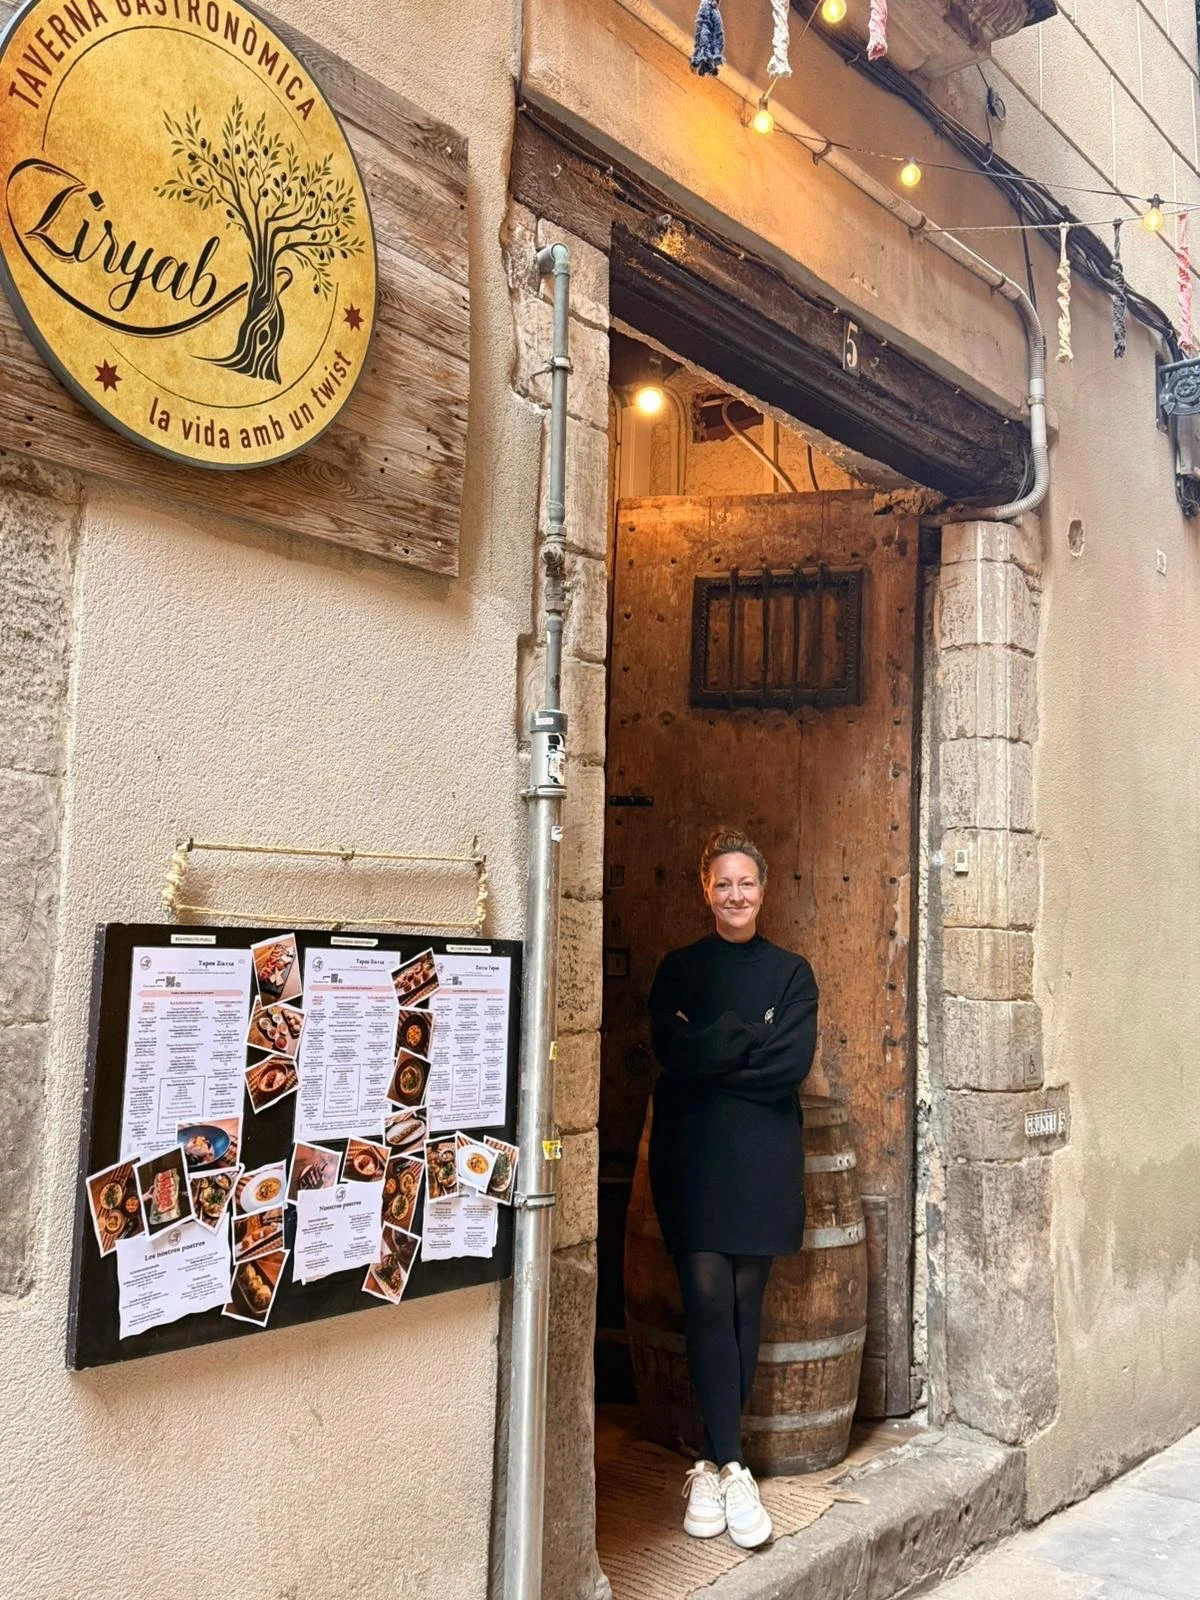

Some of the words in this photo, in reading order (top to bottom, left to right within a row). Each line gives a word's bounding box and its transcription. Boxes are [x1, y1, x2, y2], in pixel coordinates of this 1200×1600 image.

[8, 0, 109, 109] TAVERNA
[6, 158, 220, 312] Ziryab
[846, 321, 858, 368] 5
[149, 397, 170, 432] la
[181, 418, 230, 449] vida
[240, 416, 286, 449] amb
[291, 402, 314, 431] un
[312, 349, 352, 410] twist
